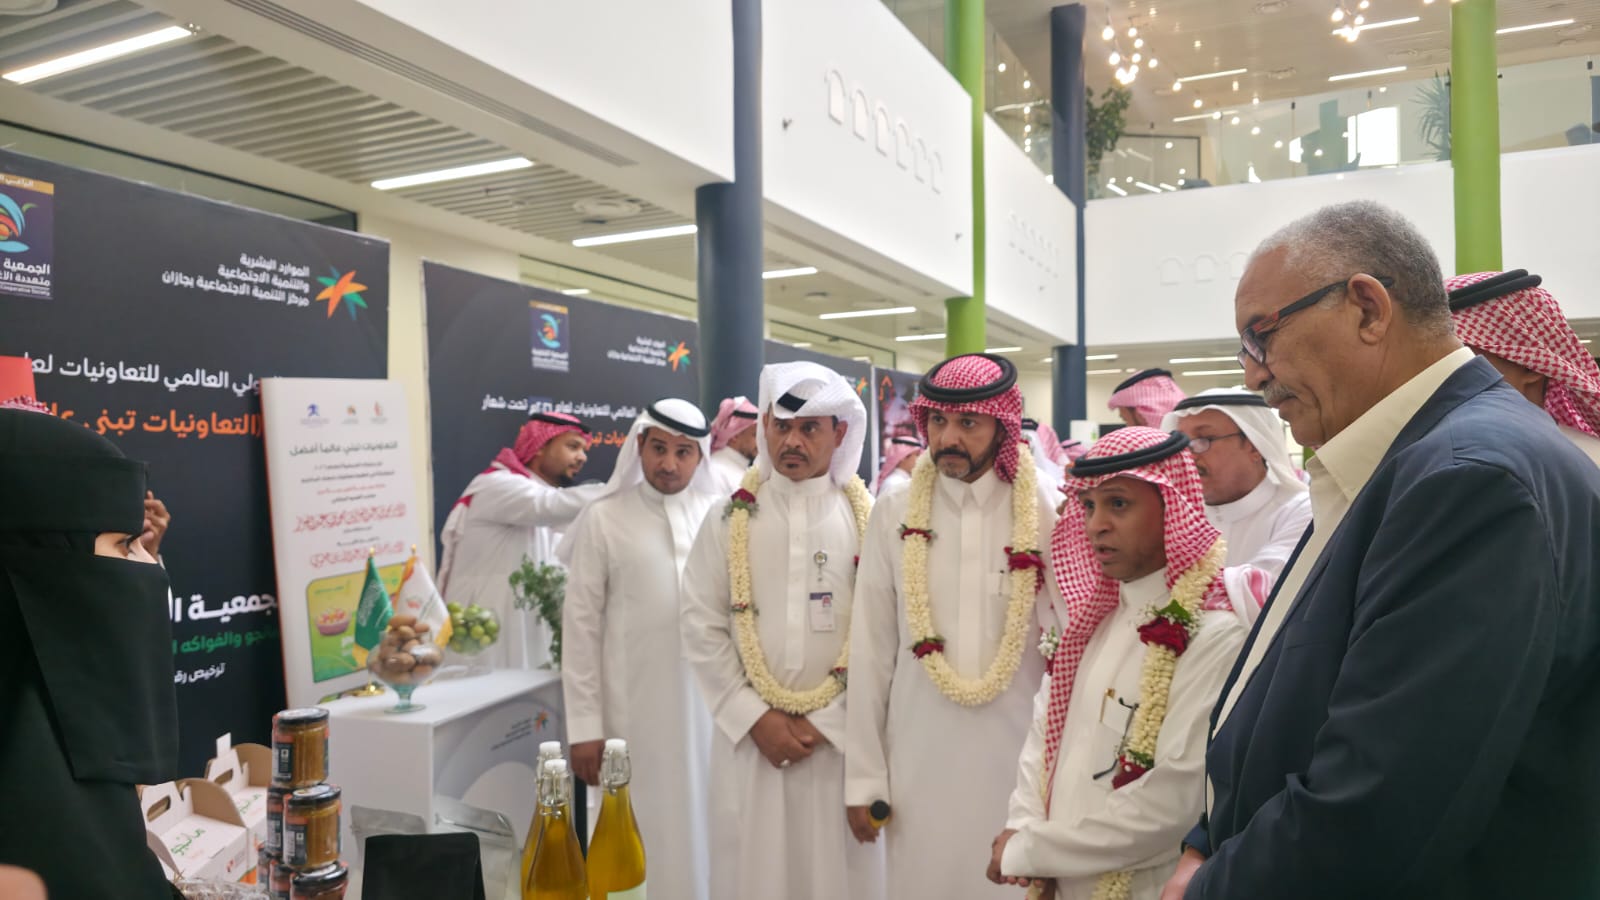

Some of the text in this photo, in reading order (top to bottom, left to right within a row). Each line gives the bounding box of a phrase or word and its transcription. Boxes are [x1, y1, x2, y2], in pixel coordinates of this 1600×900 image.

[3, 257, 51, 276] الجمعية
[239, 252, 310, 277] الموارد البشرية
[14, 272, 51, 287] متعددة
[161, 269, 310, 307] مركز التنمية الاجتماعية بجازان
[217, 263, 310, 293] والتنمية الاجتماعية
[59, 356, 160, 384] للتعاونيات
[163, 367, 229, 392] العالمي
[481, 394, 506, 411] شعار
[187, 593, 277, 624] جمعية
[173, 662, 227, 685] ترخيص رق
